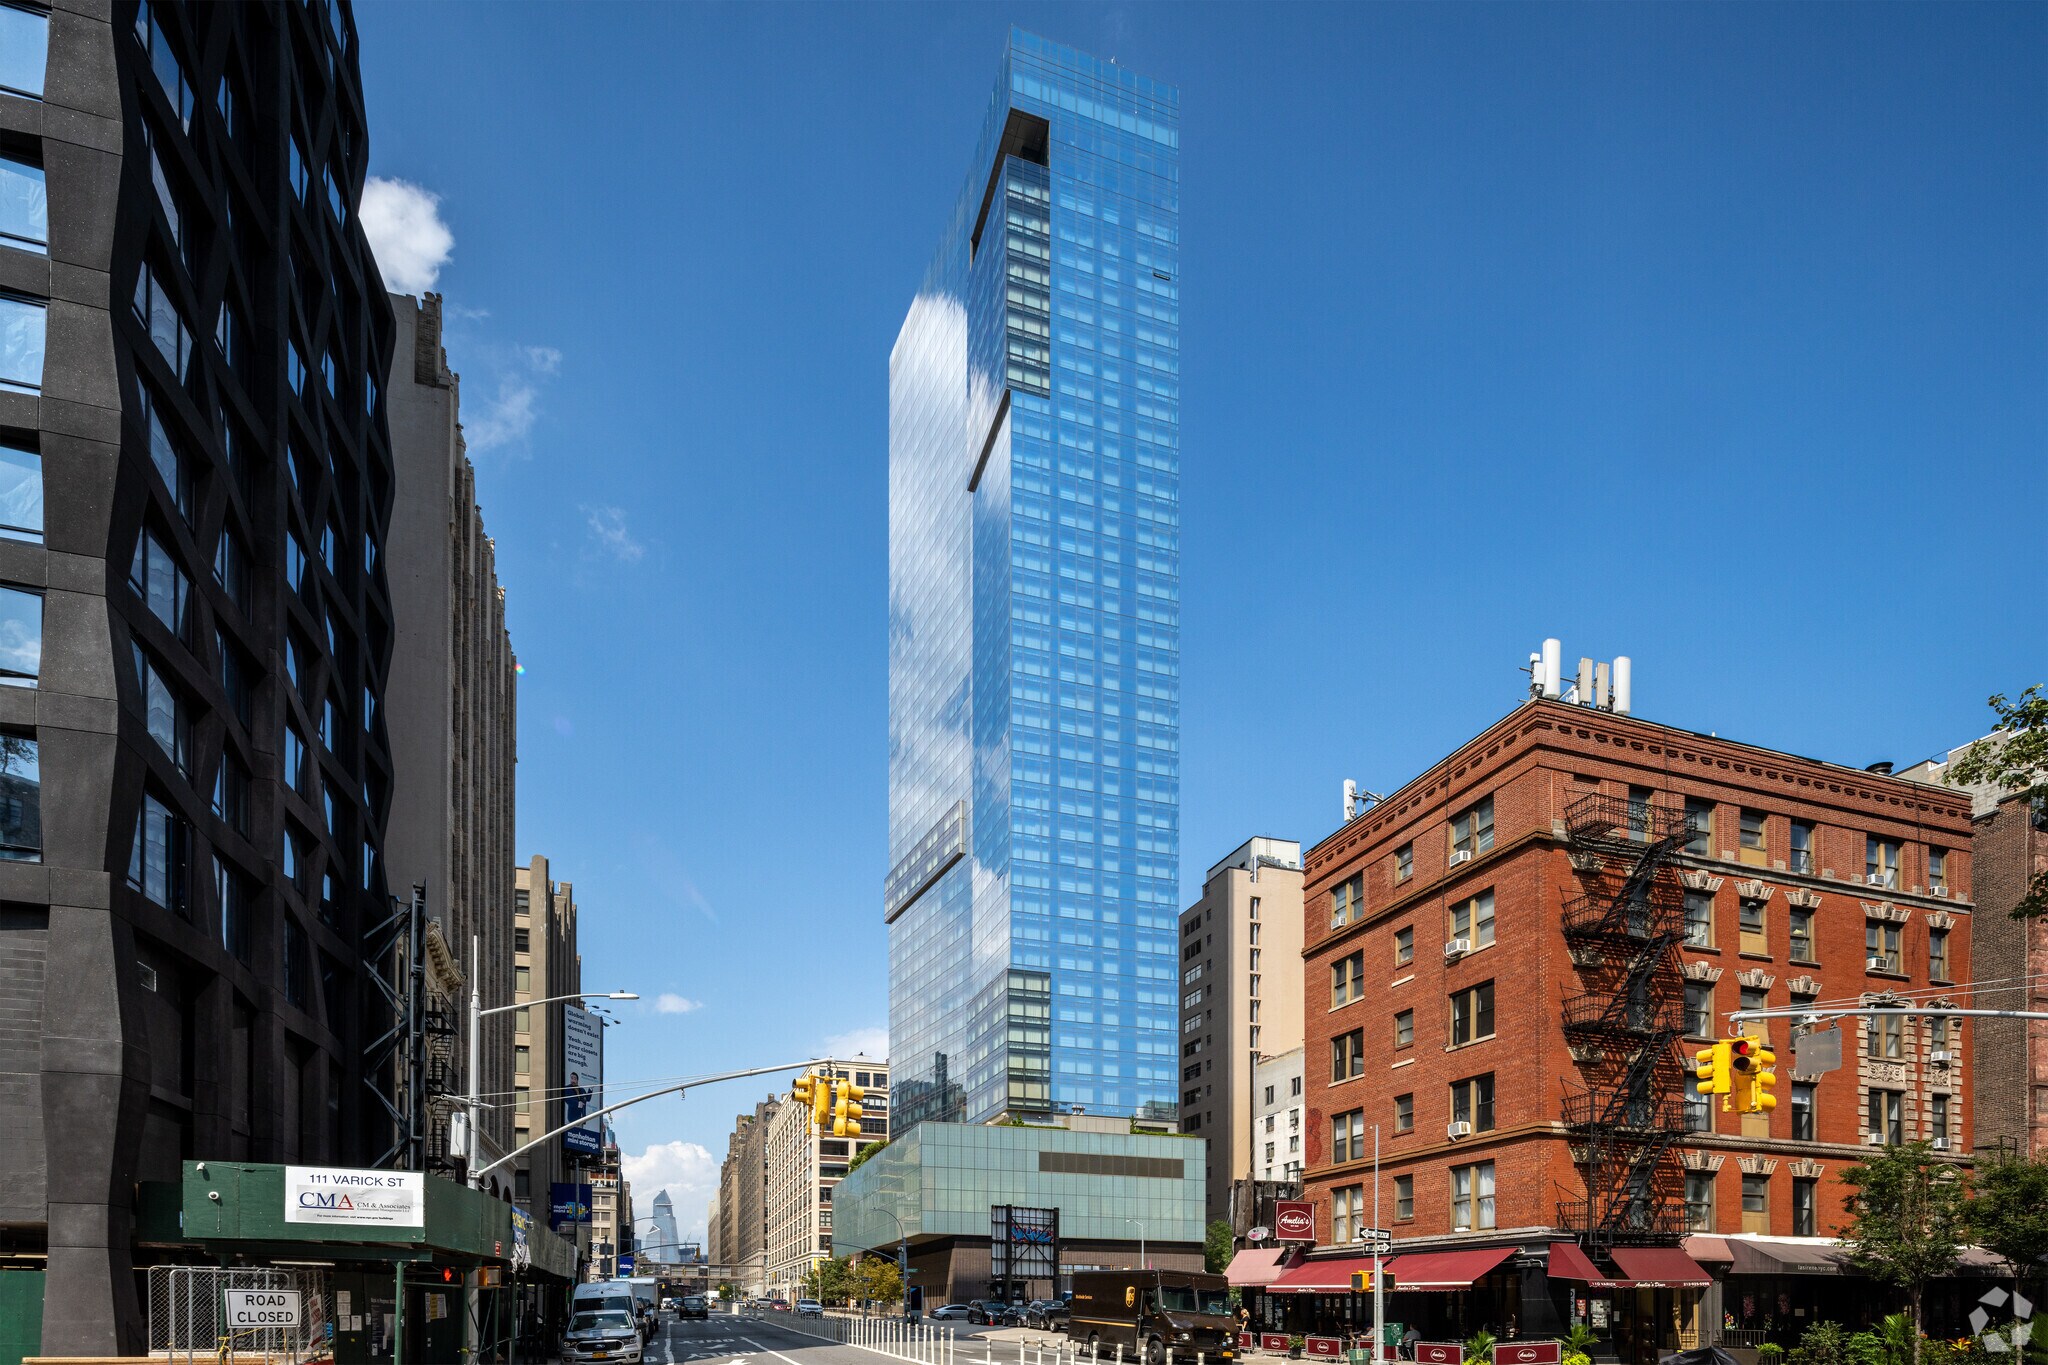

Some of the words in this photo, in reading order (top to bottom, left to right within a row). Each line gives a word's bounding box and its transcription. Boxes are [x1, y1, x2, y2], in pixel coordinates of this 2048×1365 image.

[568, 1010, 585, 1020] Global
[568, 1018, 592, 1030] warming
[568, 1025, 587, 1035] doesn't
[577, 1052, 586, 1060] big
[581, 1047, 598, 1056] closets
[567, 1131, 596, 1143] manhattan
[579, 1140, 599, 1150] storage
[310, 1174, 328, 1184] 111
[332, 1175, 384, 1187] VARICK
[387, 1177, 405, 1188] ST
[299, 1192, 354, 1209] CMA
[1280, 1215, 1309, 1225] Amelia's
[1797, 1264, 1837, 1272] lasireneyc.com
[245, 1295, 286, 1306] ROAD
[237, 1312, 294, 1322] CLOSED
